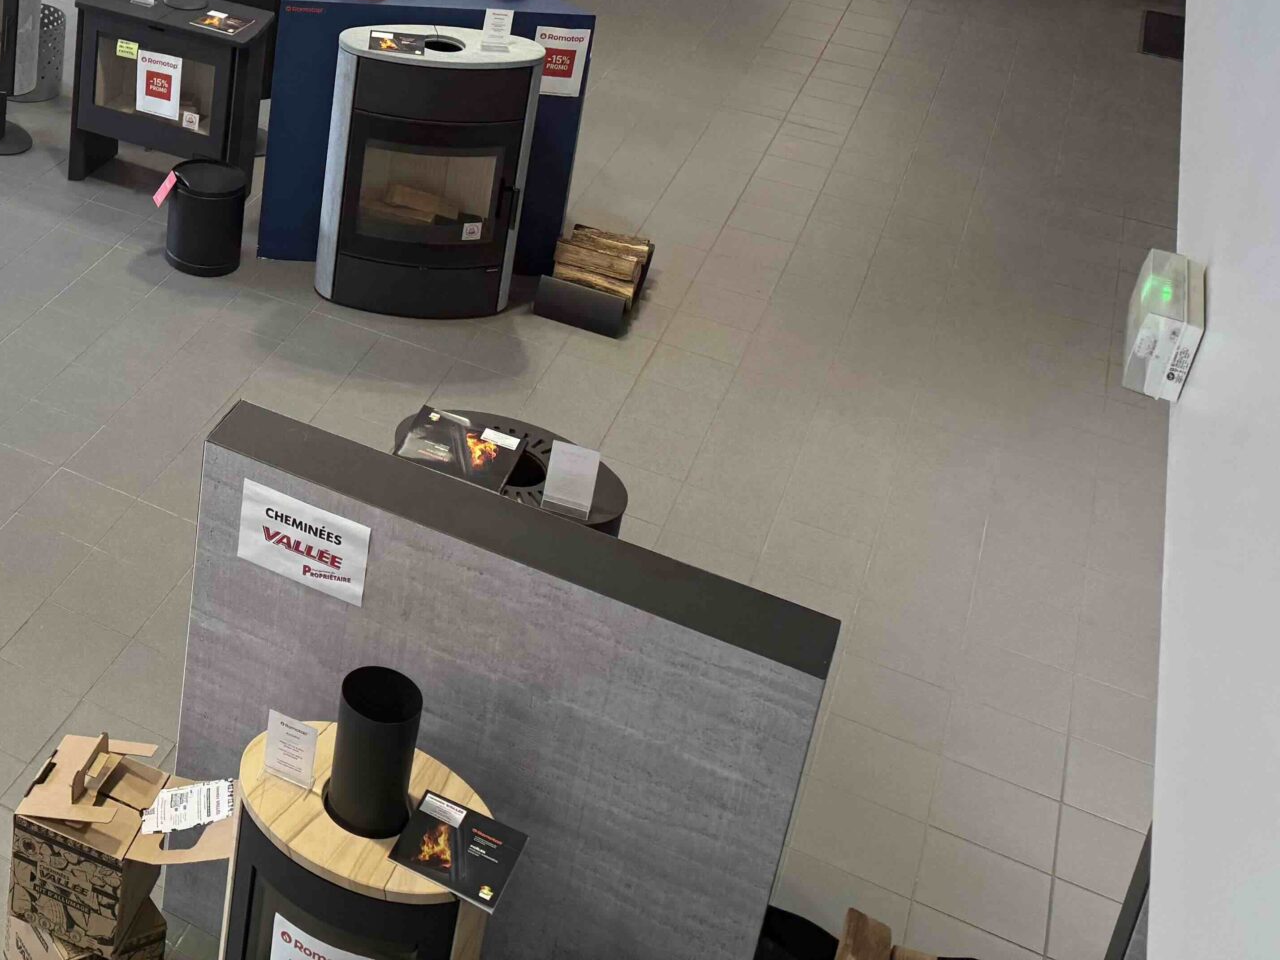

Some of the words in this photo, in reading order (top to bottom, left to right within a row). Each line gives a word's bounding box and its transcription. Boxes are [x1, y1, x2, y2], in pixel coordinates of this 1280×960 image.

[547, 33, 585, 43] Romotop
[147, 58, 178, 70] Romotop
[547, 55, 570, 65] -15%
[546, 63, 568, 71] PROMO
[150, 77, 169, 88] -15%
[149, 85, 168, 94] PROMO
[265, 507, 342, 546] CHEMINÉES
[262, 525, 343, 570] VALLÉE
